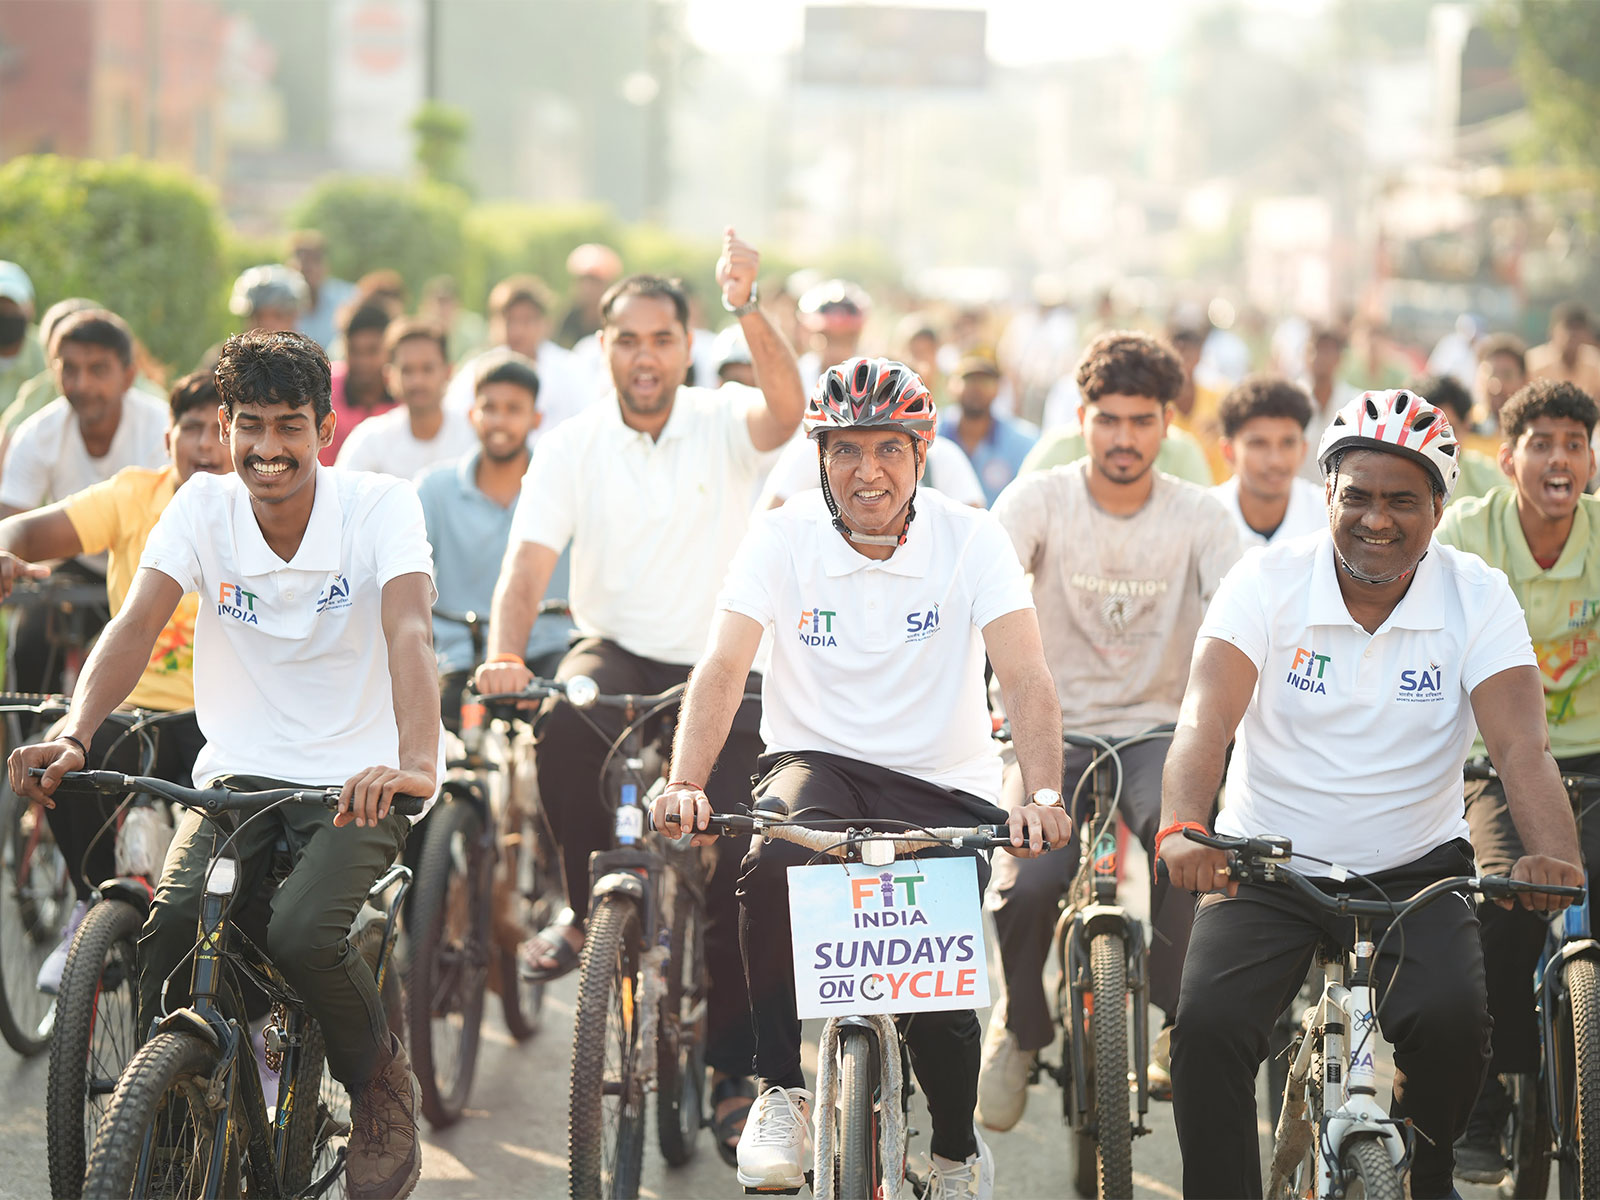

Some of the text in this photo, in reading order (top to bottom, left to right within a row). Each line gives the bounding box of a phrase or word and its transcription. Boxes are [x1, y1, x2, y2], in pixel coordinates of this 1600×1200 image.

[219, 582, 259, 611] FIT
[1071, 573, 1168, 597] MOTVATION
[218, 605, 258, 625] INDIA
[798, 608, 836, 633] FIT
[906, 608, 939, 632] SAI
[798, 632, 837, 647] NDIA
[1291, 648, 1331, 679] FIT
[1286, 672, 1326, 695] INDIA
[1399, 669, 1441, 692] SAI
[851, 872, 924, 909] FIT
[854, 909, 928, 929] INDIA
[814, 934, 974, 970] SUNDAYS
[819, 968, 977, 1001] ON CYCLE
